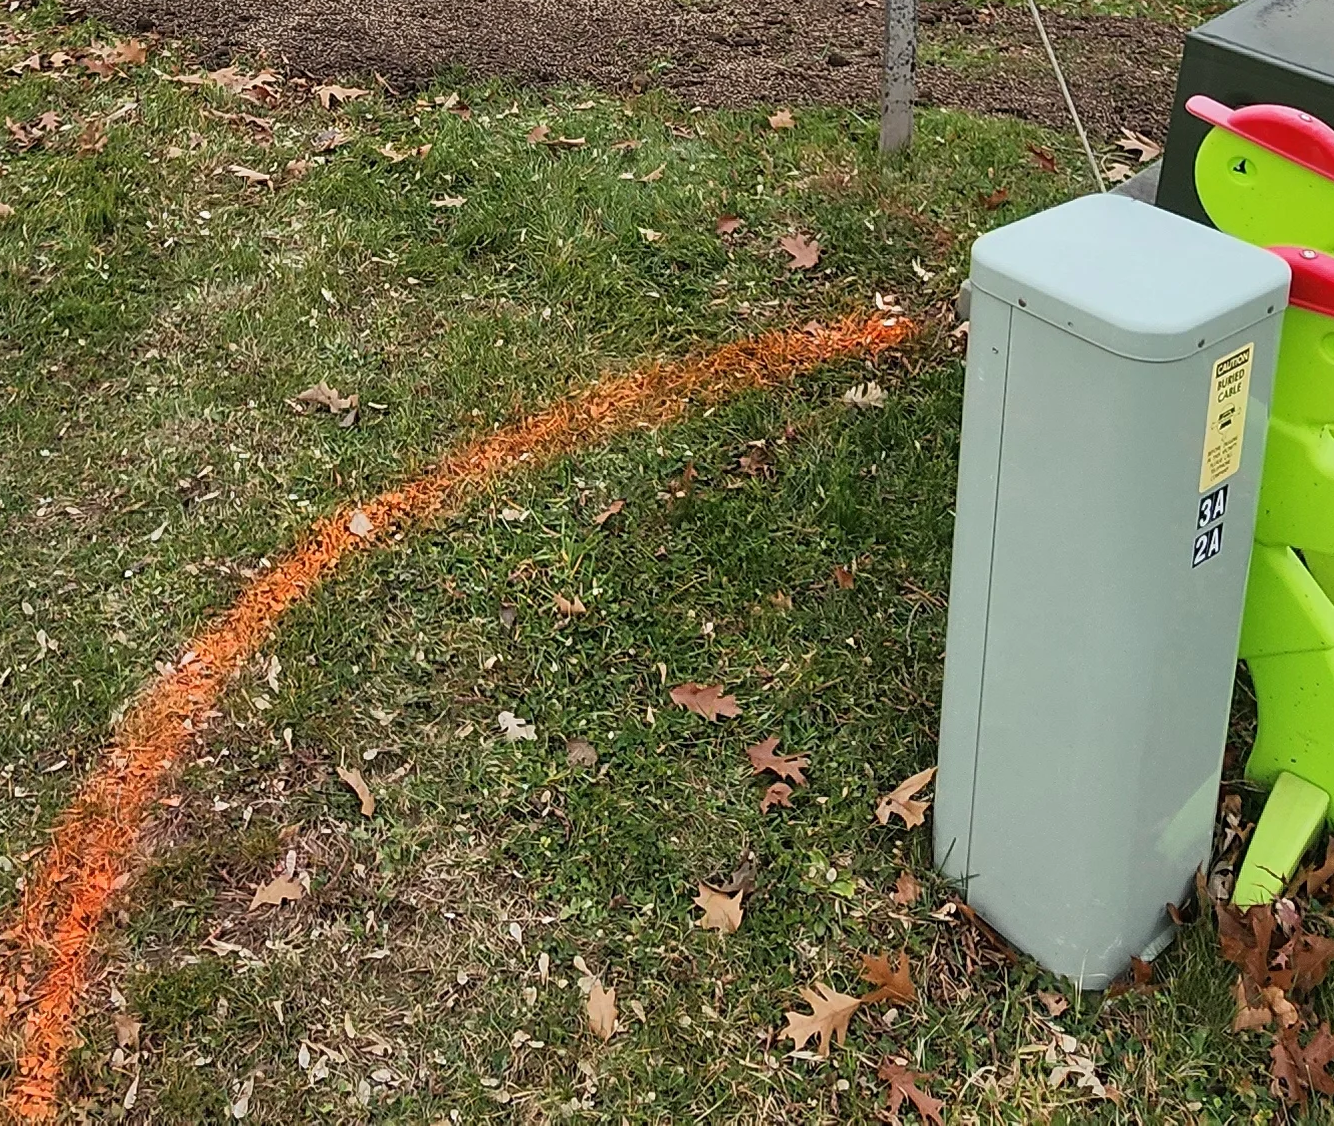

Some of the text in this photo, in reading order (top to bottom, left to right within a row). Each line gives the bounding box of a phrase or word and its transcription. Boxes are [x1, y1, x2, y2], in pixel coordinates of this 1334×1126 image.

[1217, 351, 1249, 375] CAUTION
[1217, 368, 1245, 391] BURIED
[1218, 382, 1241, 403] CABLE
[1199, 489, 1224, 527] 3A
[1193, 527, 1219, 565] 2A
